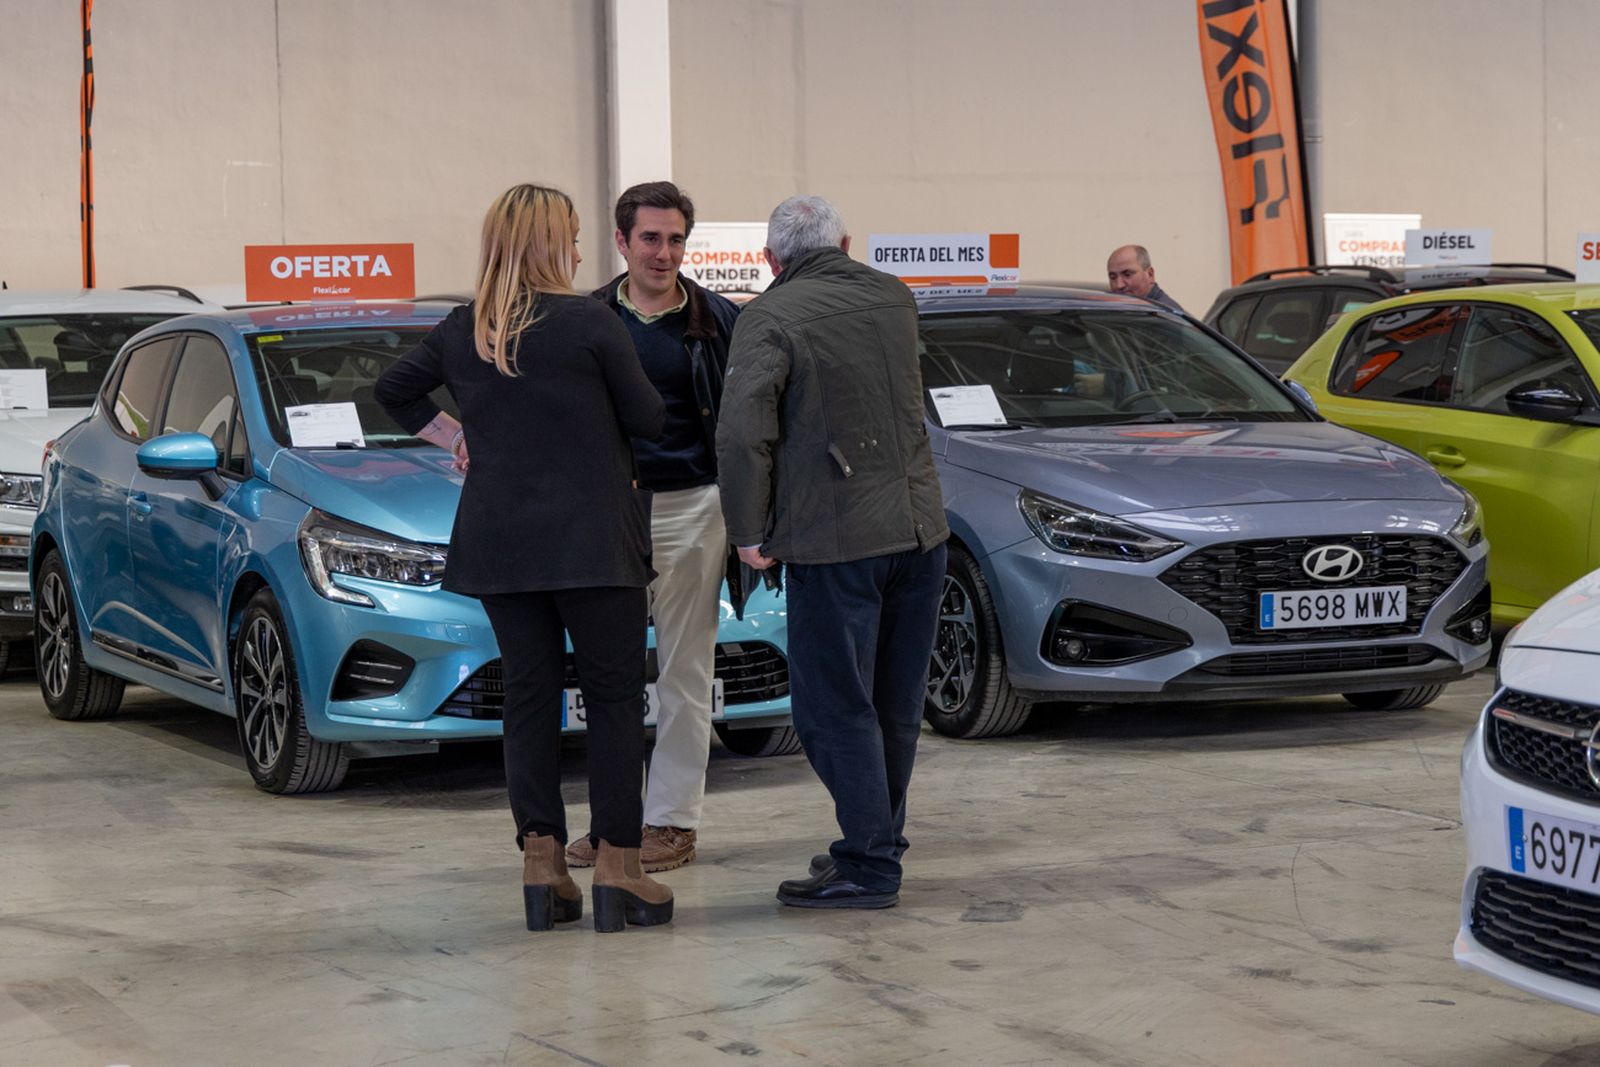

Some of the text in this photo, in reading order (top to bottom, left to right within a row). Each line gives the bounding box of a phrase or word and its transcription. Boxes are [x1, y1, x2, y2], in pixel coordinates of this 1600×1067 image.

[1423, 232, 1475, 249] DIÉSEL
[681, 251, 767, 265] COMPRAR
[875, 246, 984, 262] OFERTA DEL MES
[270, 255, 392, 279] OFERTA
[694, 268, 760, 280] VENDER
[1280, 594, 1346, 622] 5698
[1355, 591, 1401, 619] MWX
[1531, 821, 1600, 884] 6977
